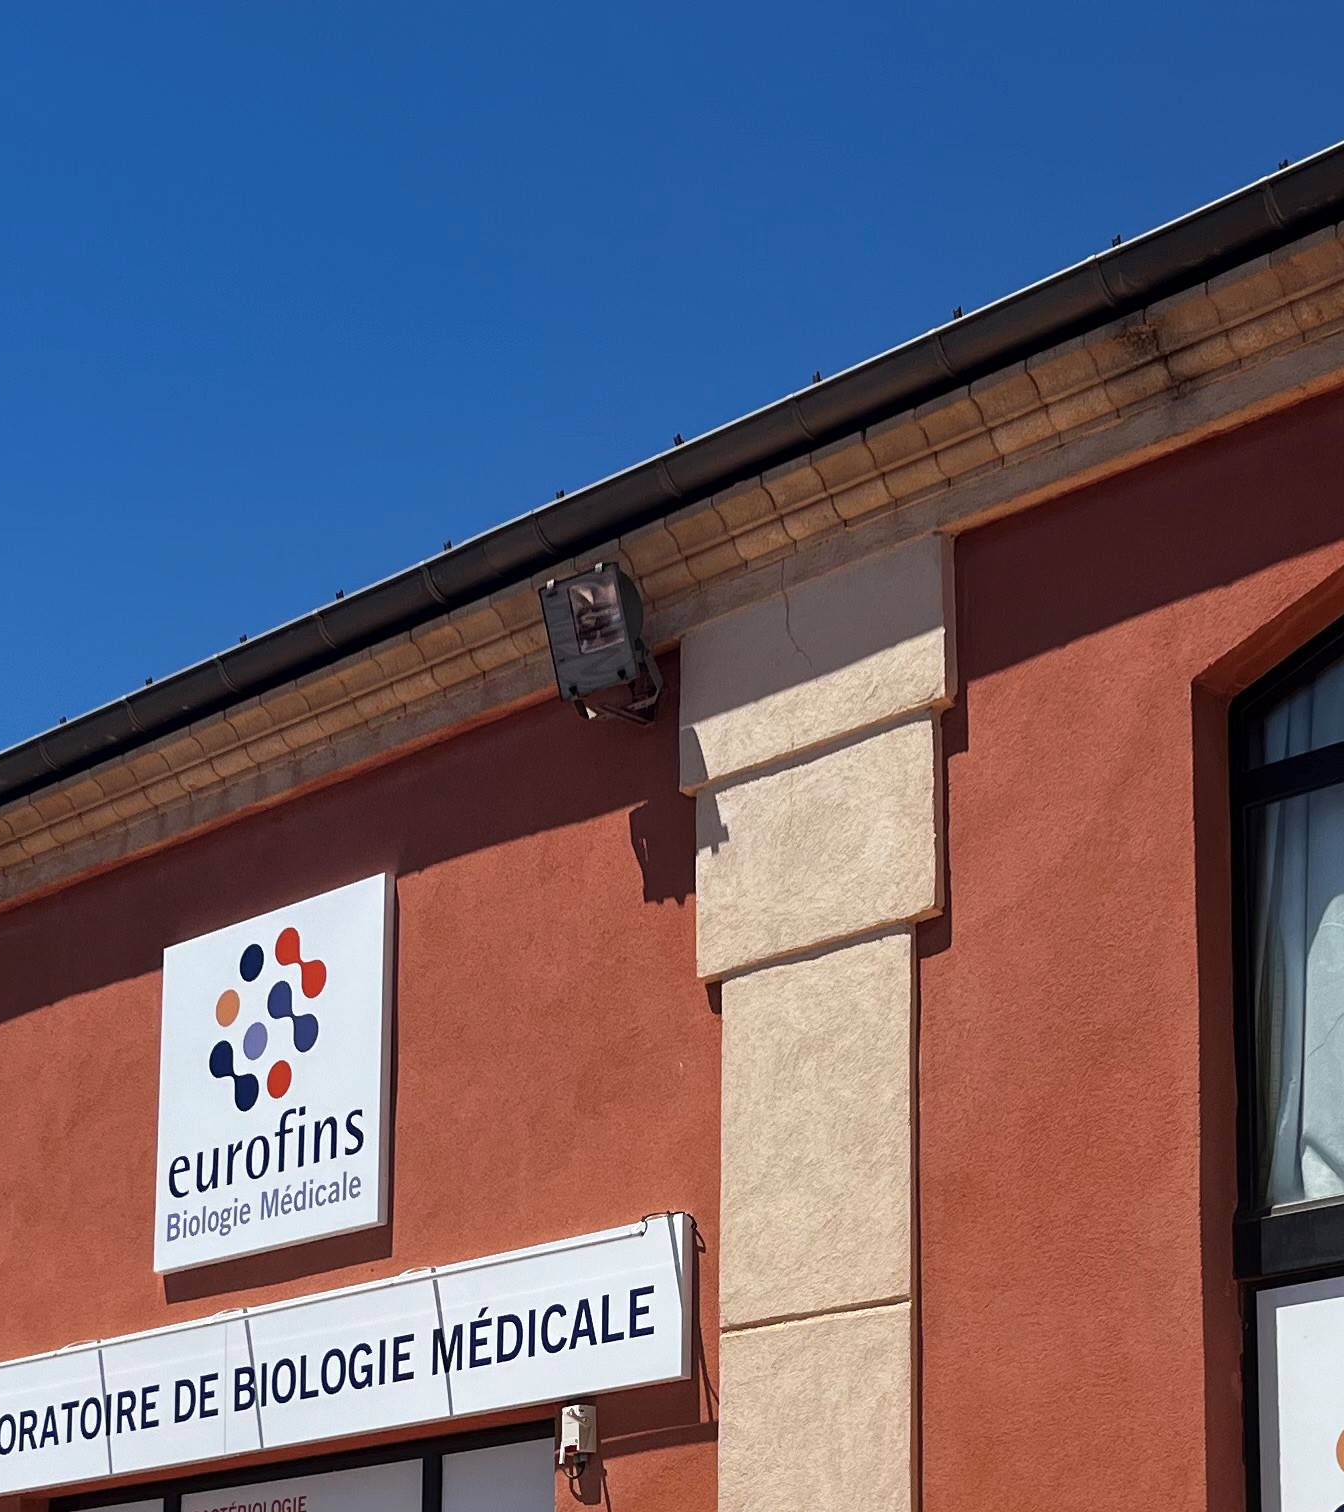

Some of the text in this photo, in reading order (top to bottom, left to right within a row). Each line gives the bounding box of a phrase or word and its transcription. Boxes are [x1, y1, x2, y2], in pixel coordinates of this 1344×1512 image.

[168, 1106, 365, 1198] eurofins
[166, 1171, 362, 1242] Biologie Médicale
[174, 1373, 219, 1425] DE
[234, 1334, 416, 1412] BIOLOGIE
[431, 1286, 656, 1376] MÉDICALE
